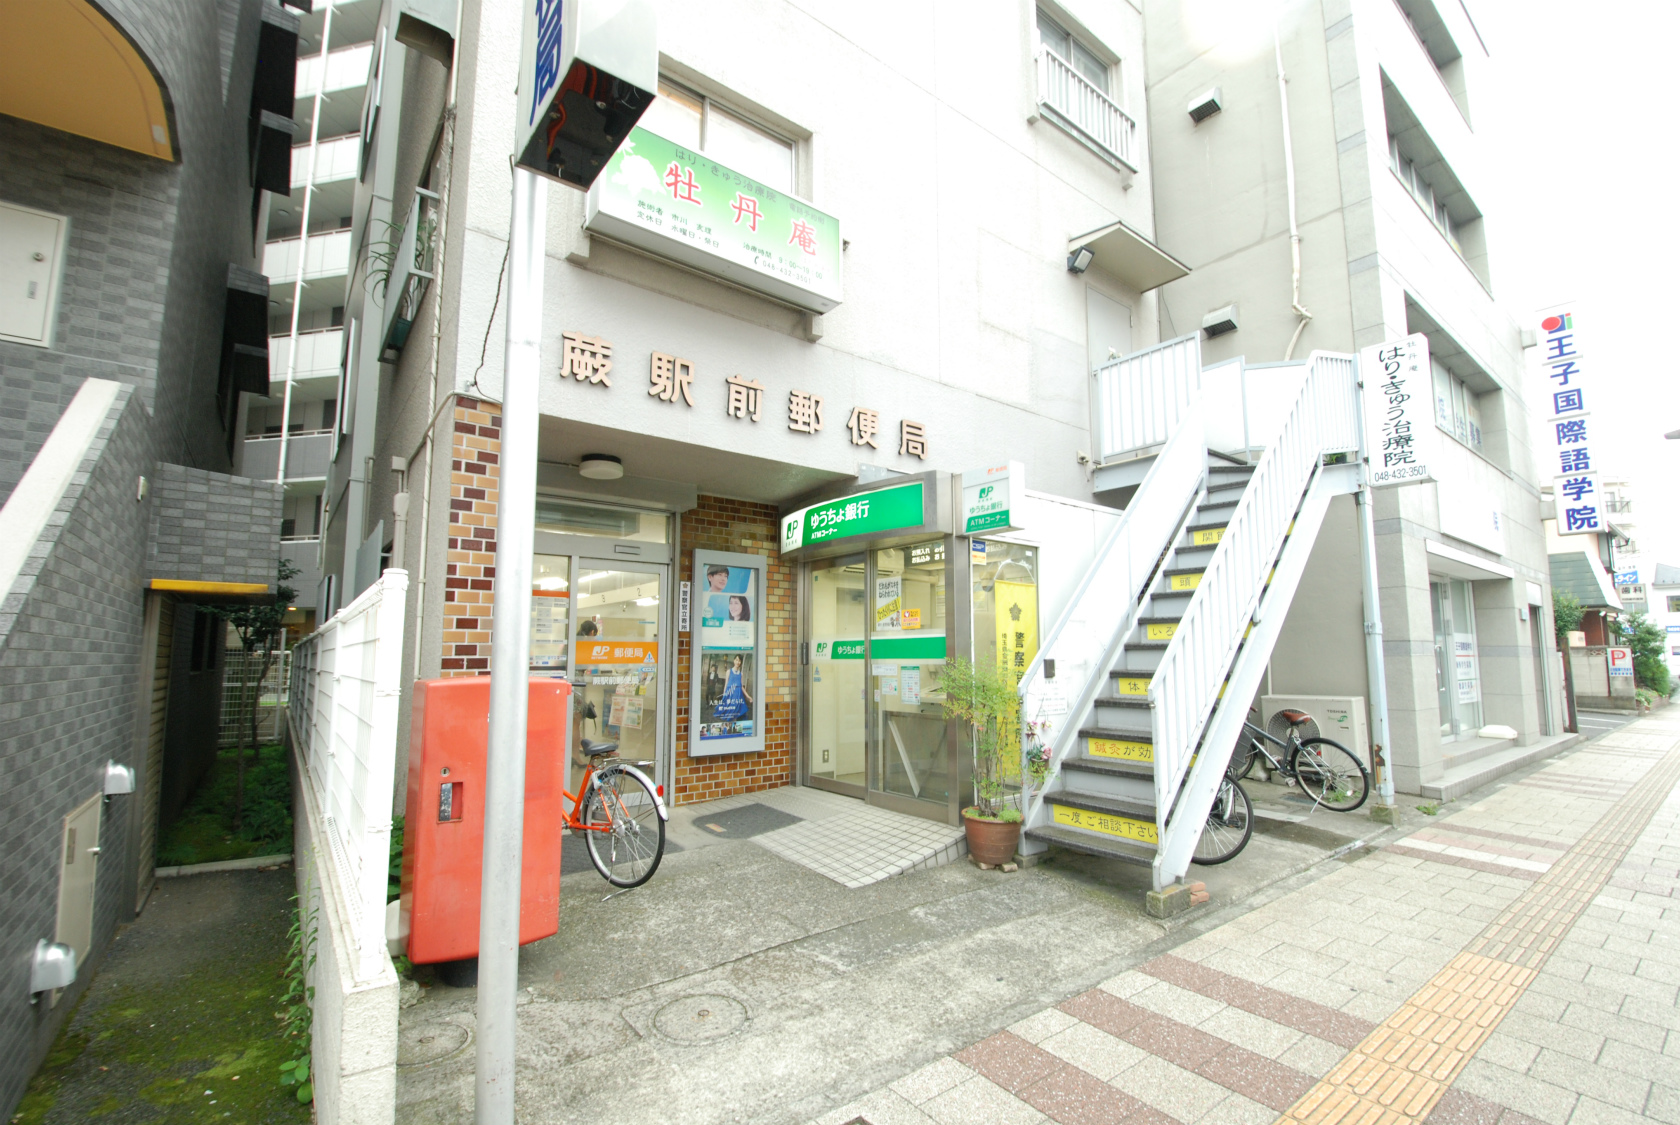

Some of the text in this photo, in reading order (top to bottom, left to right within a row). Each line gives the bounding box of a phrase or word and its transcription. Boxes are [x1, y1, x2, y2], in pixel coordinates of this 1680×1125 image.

[637, 210, 663, 226] 定休日
[665, 163, 817, 257] 牡丹庵
[560, 331, 928, 460] 蕨駅前郵便局
[1379, 346, 1416, 468] はり・きゅう治療院
[1546, 334, 1599, 531] 王子国際語学院
[1374, 464, 1427, 482] 048-432-3501
[811, 500, 870, 529] ゆうちょ銀行
[969, 501, 1003, 514] ゆうちょ銀行
[970, 515, 1007, 527] ATMコーナー
[811, 527, 838, 540] ATMコーナー
[614, 647, 643, 658] 郵便局
[1611, 649, 1626, 666] P
